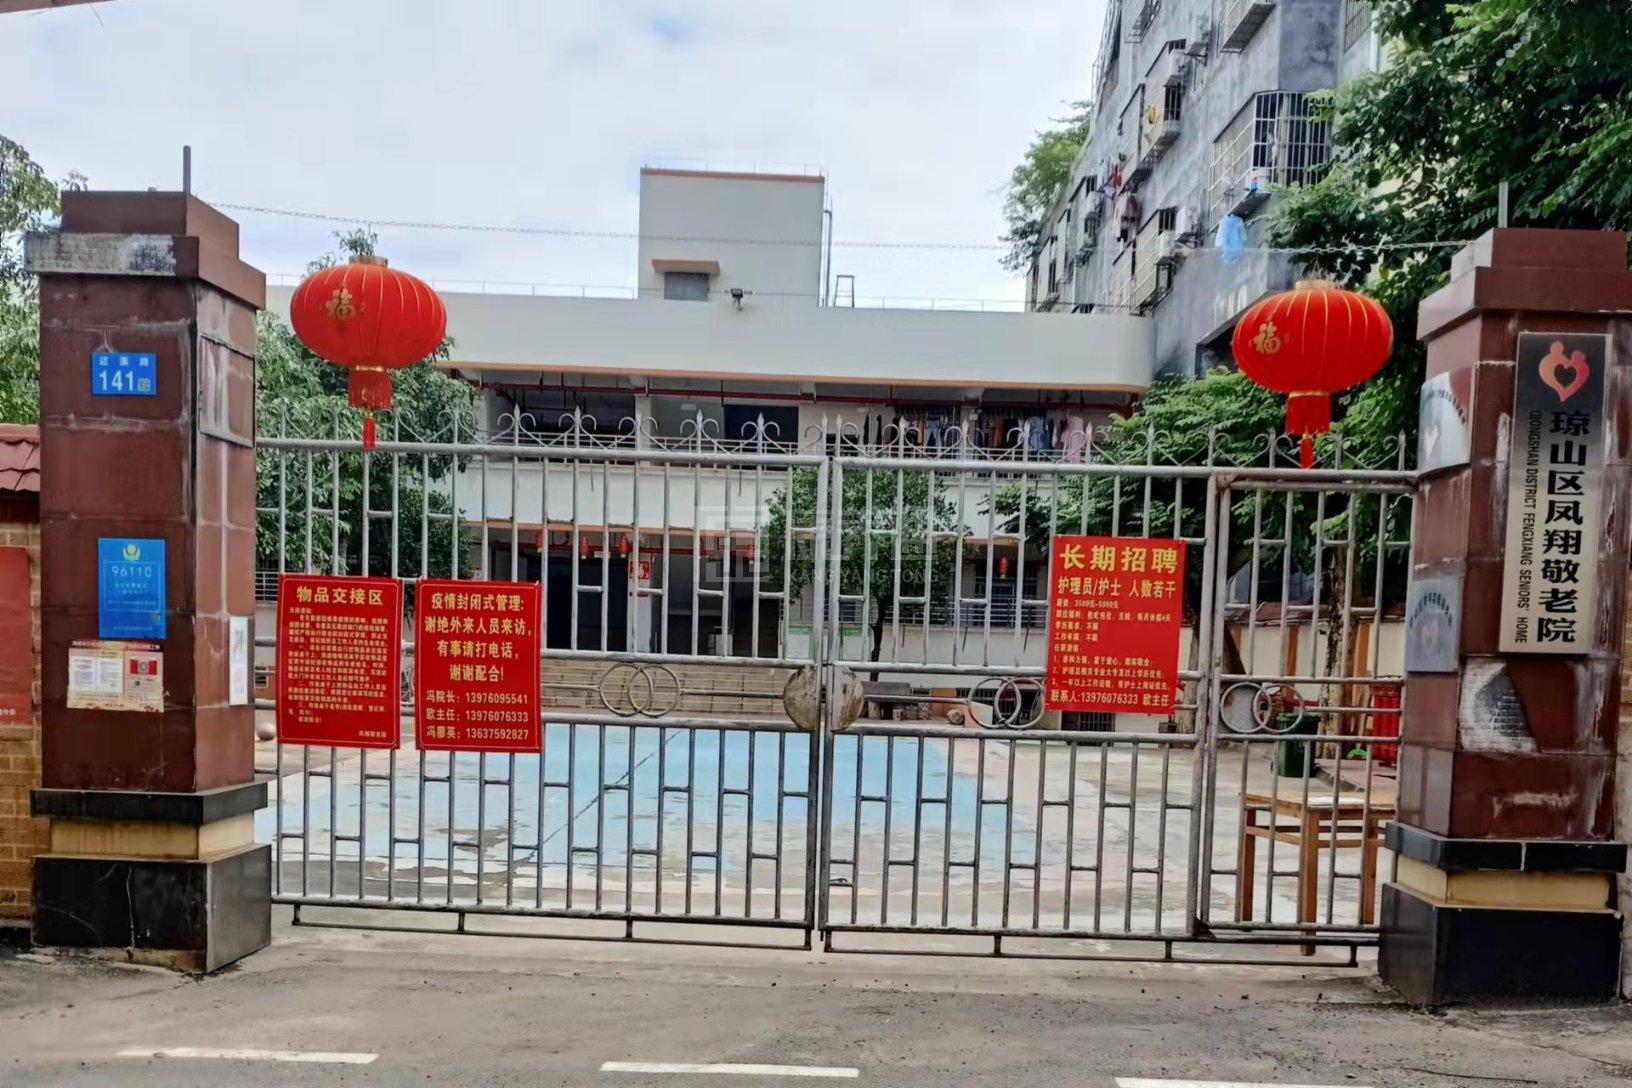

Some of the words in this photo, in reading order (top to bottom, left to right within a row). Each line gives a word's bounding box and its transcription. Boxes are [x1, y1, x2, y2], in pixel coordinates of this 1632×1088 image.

[324, 288, 356, 321] 福
[1253, 321, 1281, 354] 福
[1526, 410, 1542, 466] QIONGSHAN
[1524, 468, 1539, 510] DISTRICT
[1520, 512, 1536, 566] FENGXIANG
[1537, 410, 1591, 643] 琼山区凤翔敬老院
[111, 565, 152, 578] 96110
[1059, 543, 1178, 575] 长期招聘
[295, 585, 384, 606] 物品交接区
[1057, 576, 1122, 597] 护理员/护士
[1129, 579, 1177, 599] 人数若干
[1515, 616, 1529, 644] HOME
